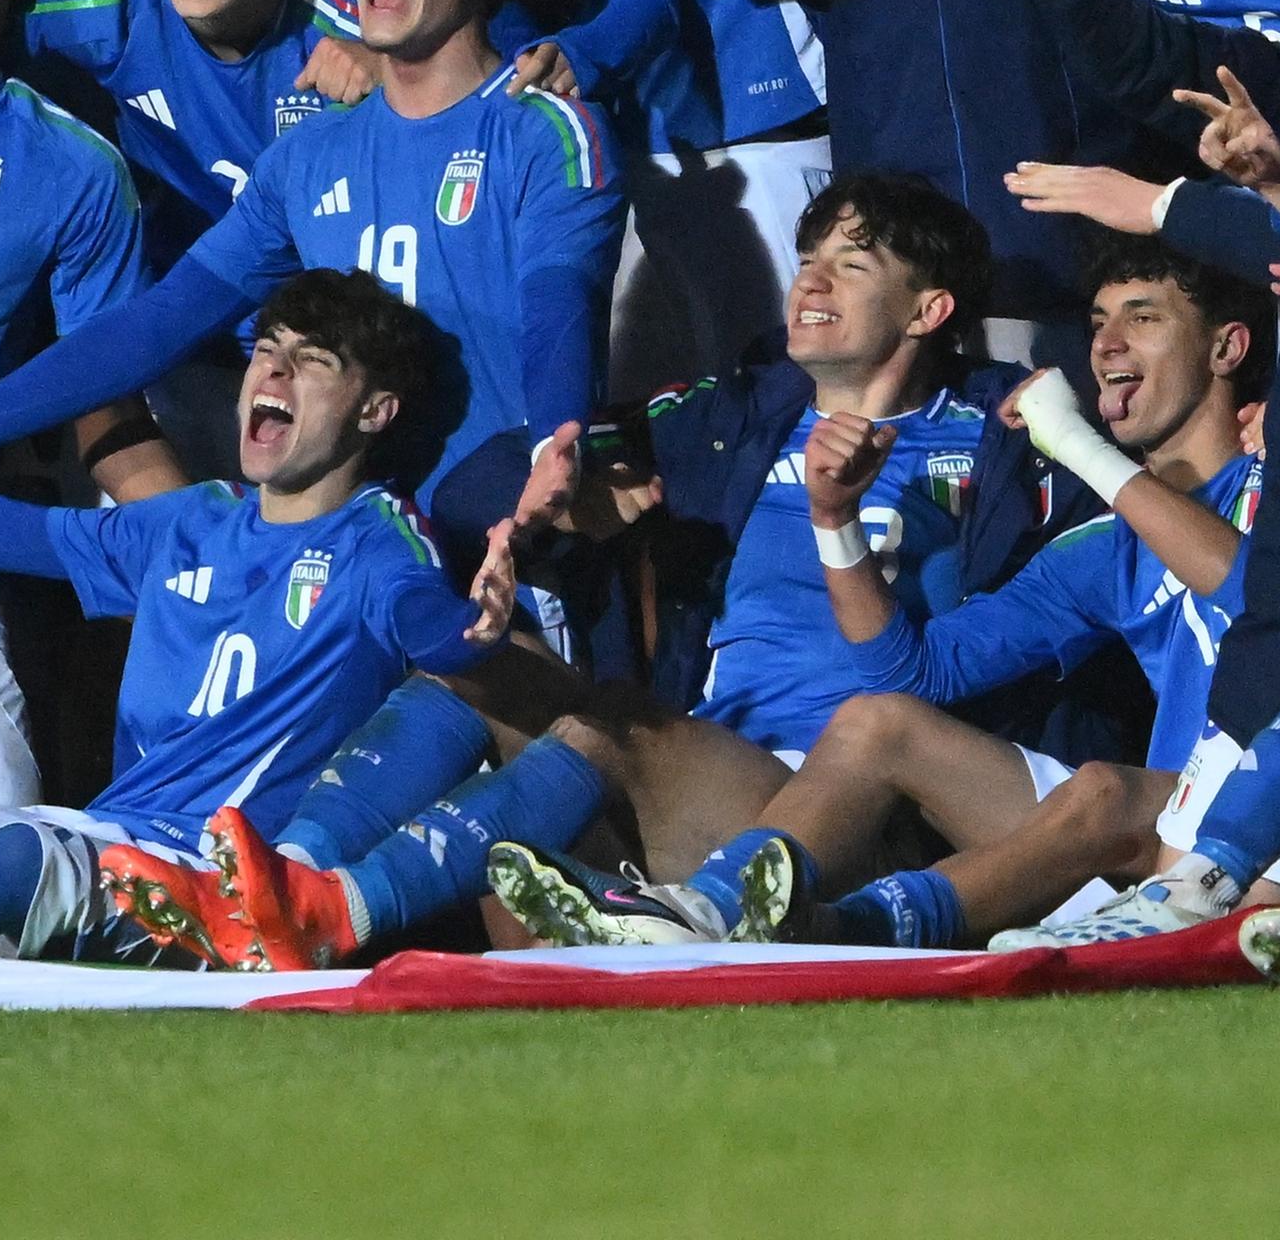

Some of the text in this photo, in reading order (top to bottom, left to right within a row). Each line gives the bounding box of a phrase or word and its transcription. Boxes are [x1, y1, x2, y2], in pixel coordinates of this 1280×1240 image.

[448, 165, 478, 178] ITALIA
[357, 223, 418, 307] 19
[932, 461, 970, 475] ITALIA
[293, 566, 325, 580] ITALIA
[187, 631, 257, 718] 10
